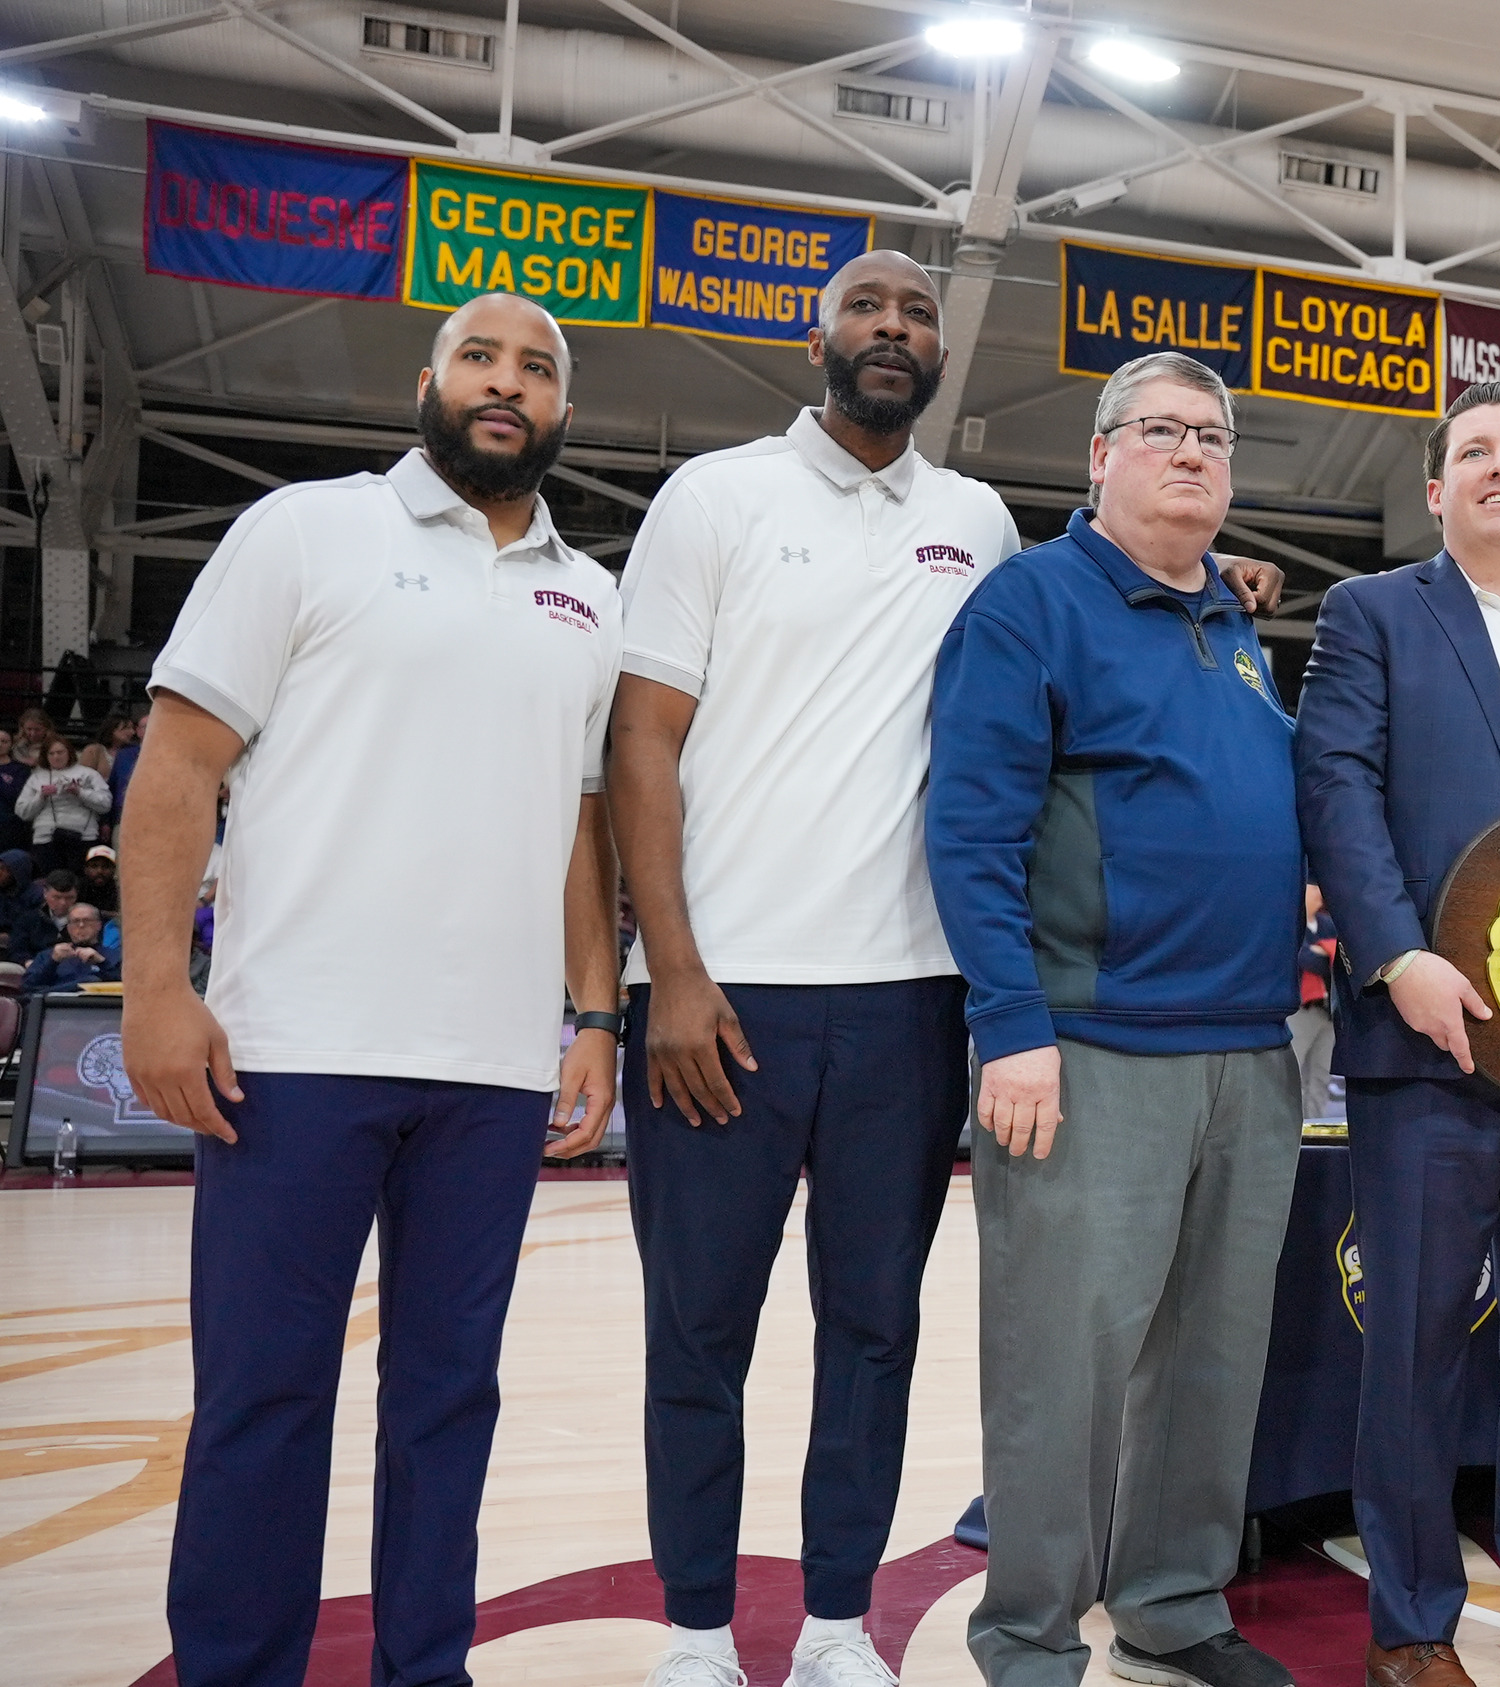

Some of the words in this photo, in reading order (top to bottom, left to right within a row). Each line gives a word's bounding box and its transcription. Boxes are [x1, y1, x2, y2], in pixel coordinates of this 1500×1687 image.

[157, 170, 395, 253] DUQUESNE
[430, 187, 636, 250] GEORGE
[437, 241, 621, 301] MASON
[693, 218, 831, 270] GEORGE
[659, 266, 826, 323] WASHINGT
[1077, 284, 1121, 339] LA
[1131, 295, 1243, 351] SALLE
[1274, 290, 1426, 348] LOYOLA
[1266, 336, 1431, 394] CHICAGO
[916, 544, 975, 569] STEPINAC
[930, 564, 968, 577] BASKETBALL
[549, 610, 592, 634] BASKETBALL
